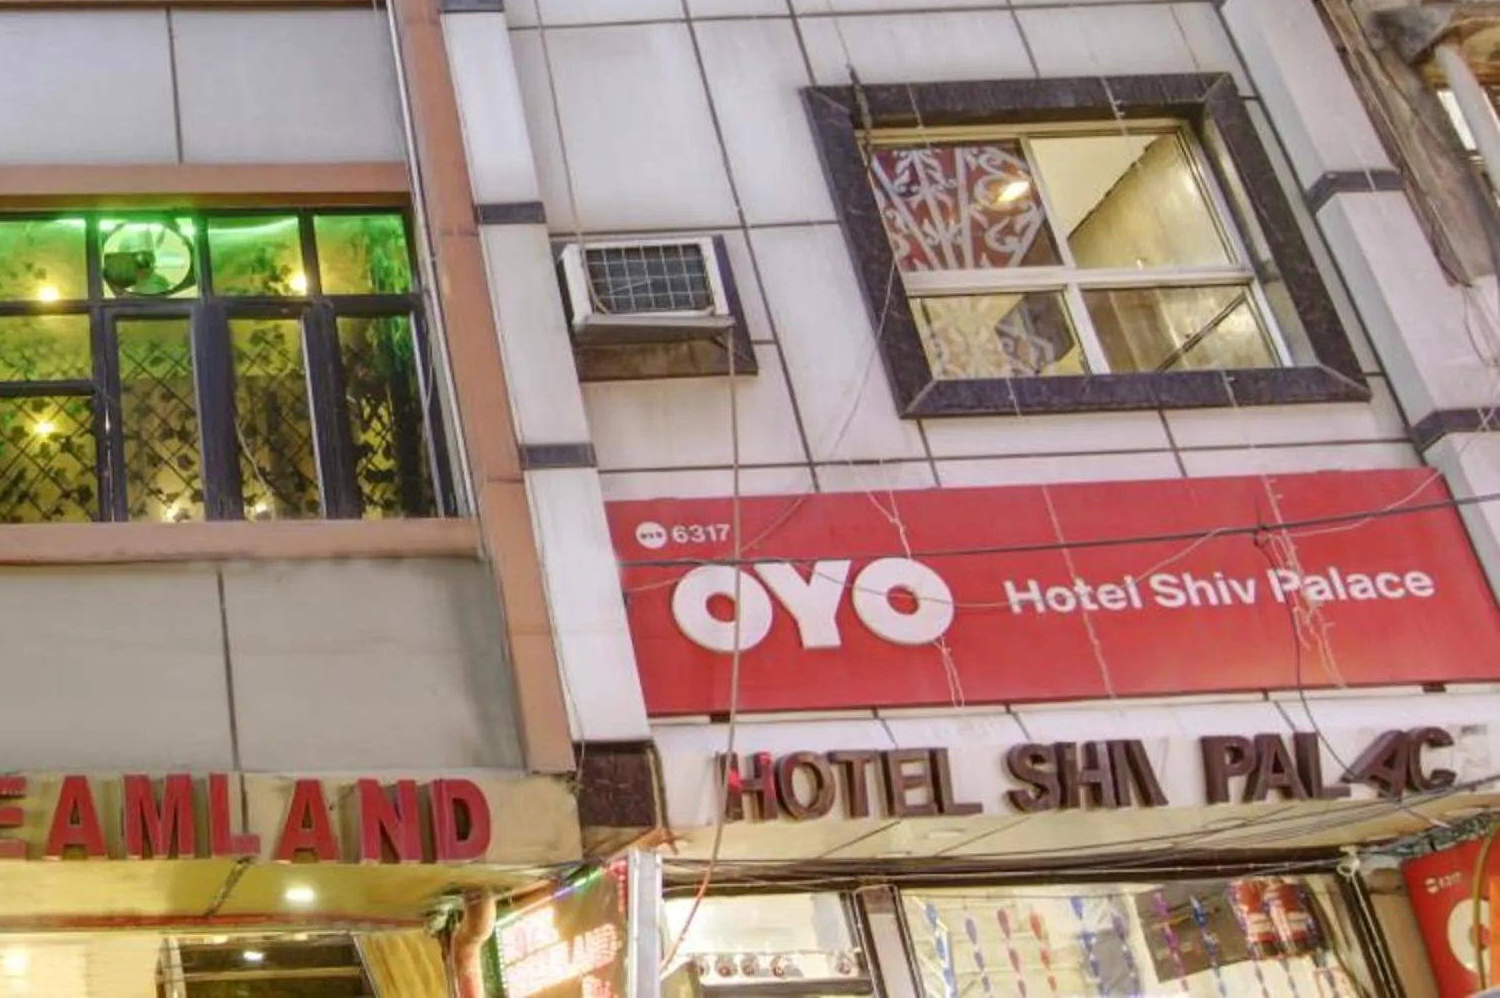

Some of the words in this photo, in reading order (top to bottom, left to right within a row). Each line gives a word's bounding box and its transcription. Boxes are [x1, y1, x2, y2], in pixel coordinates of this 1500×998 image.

[671, 523, 731, 544] 6317
[672, 558, 955, 653] OYO
[1003, 575, 1143, 615] Hotel
[1148, 571, 1257, 609] Shiv
[1266, 566, 1436, 604] Palace
[716, 747, 984, 822] HOTEL
